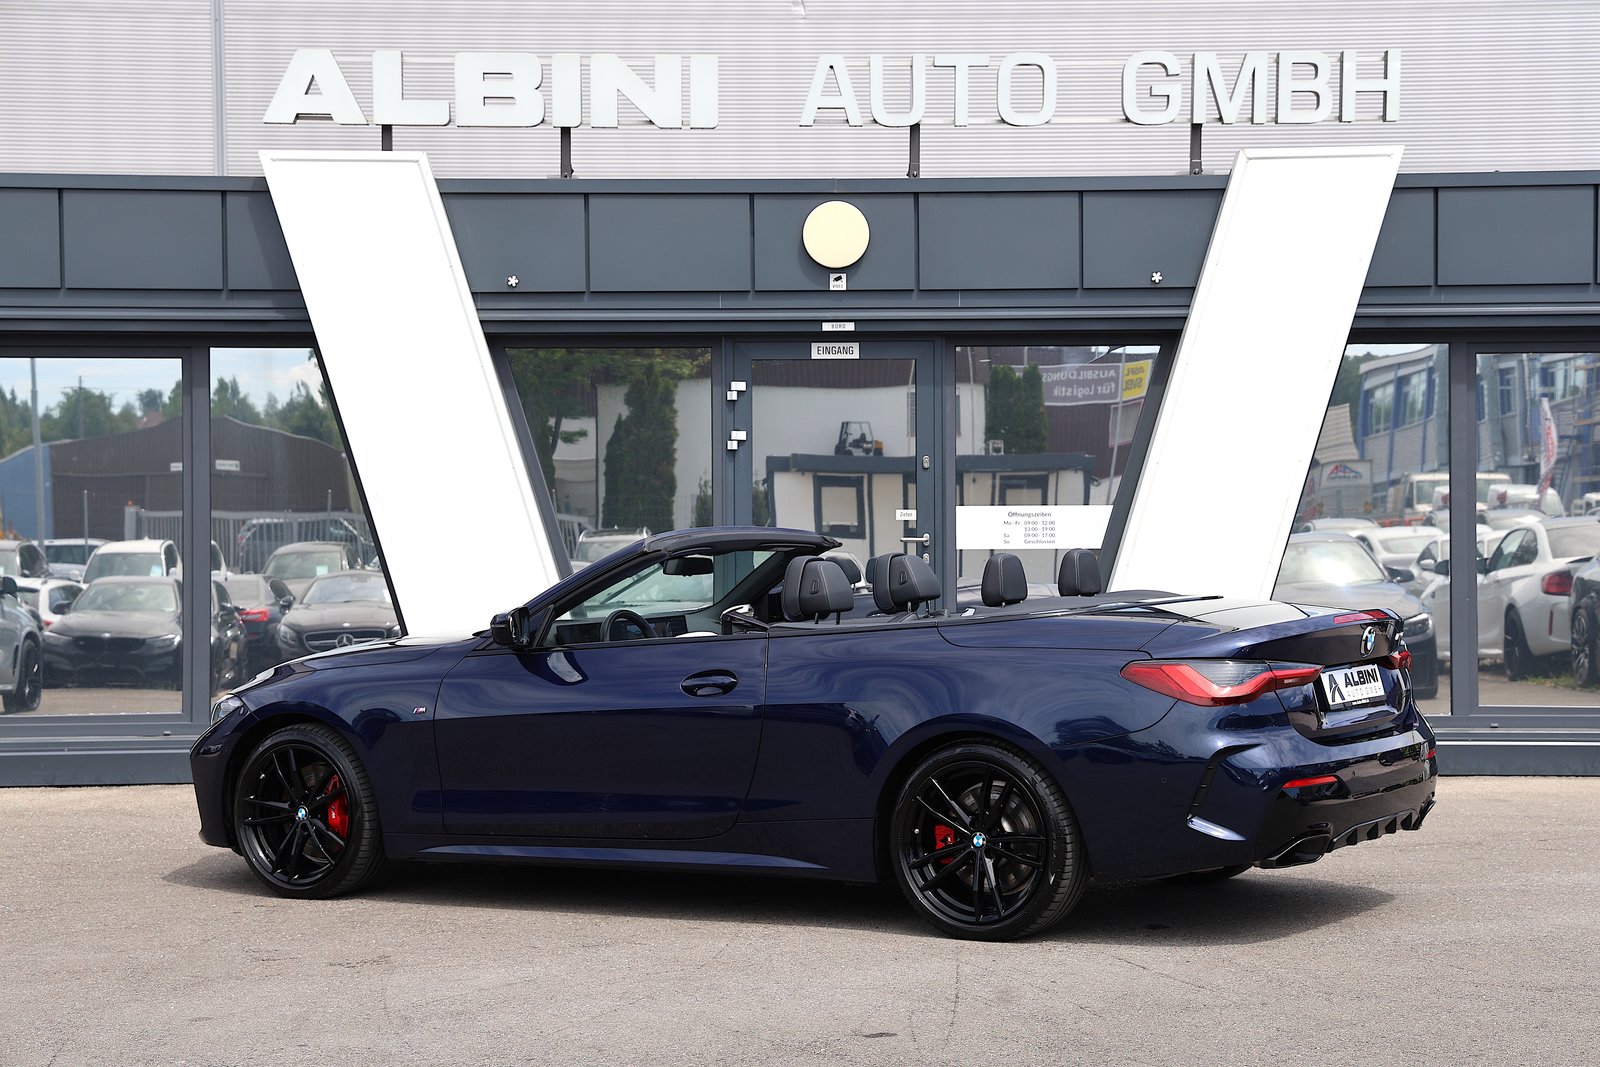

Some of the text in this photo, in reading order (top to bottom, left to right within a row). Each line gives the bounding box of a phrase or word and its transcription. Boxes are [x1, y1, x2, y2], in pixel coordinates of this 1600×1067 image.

[263, 49, 1402, 129] ALBINI AUTO GMBH
[817, 346, 854, 355] EINGANG
[1344, 668, 1379, 688] ALBINI
